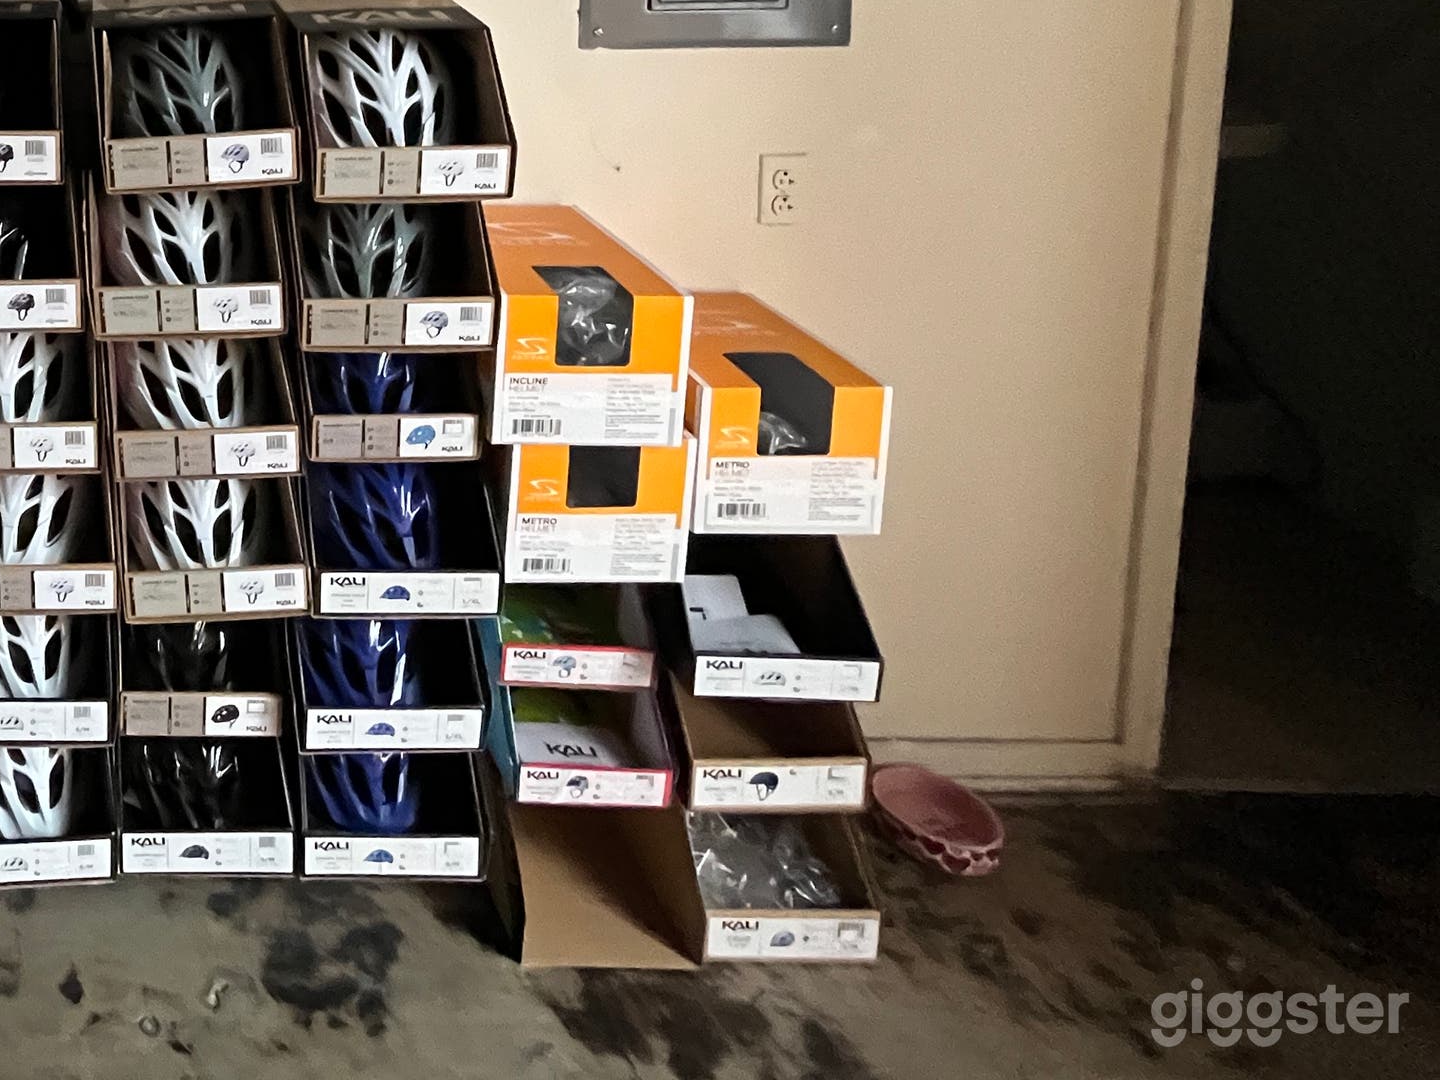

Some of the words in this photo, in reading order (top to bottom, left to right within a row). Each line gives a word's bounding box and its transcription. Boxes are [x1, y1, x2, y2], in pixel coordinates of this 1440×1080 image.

[474, 182, 496, 190] KALI
[509, 377, 548, 385] INCLINE
[522, 517, 558, 525] METRO
[330, 577, 366, 587] KALI
[513, 650, 547, 659] KALI
[706, 660, 743, 670] KALI
[317, 715, 352, 724] KALI
[544, 742, 598, 759] KALI
[527, 770, 559, 780] KALI
[703, 769, 742, 780] KALI
[131, 837, 166, 847] KALI
[314, 842, 350, 851] KALI
[722, 921, 759, 930] KALI
